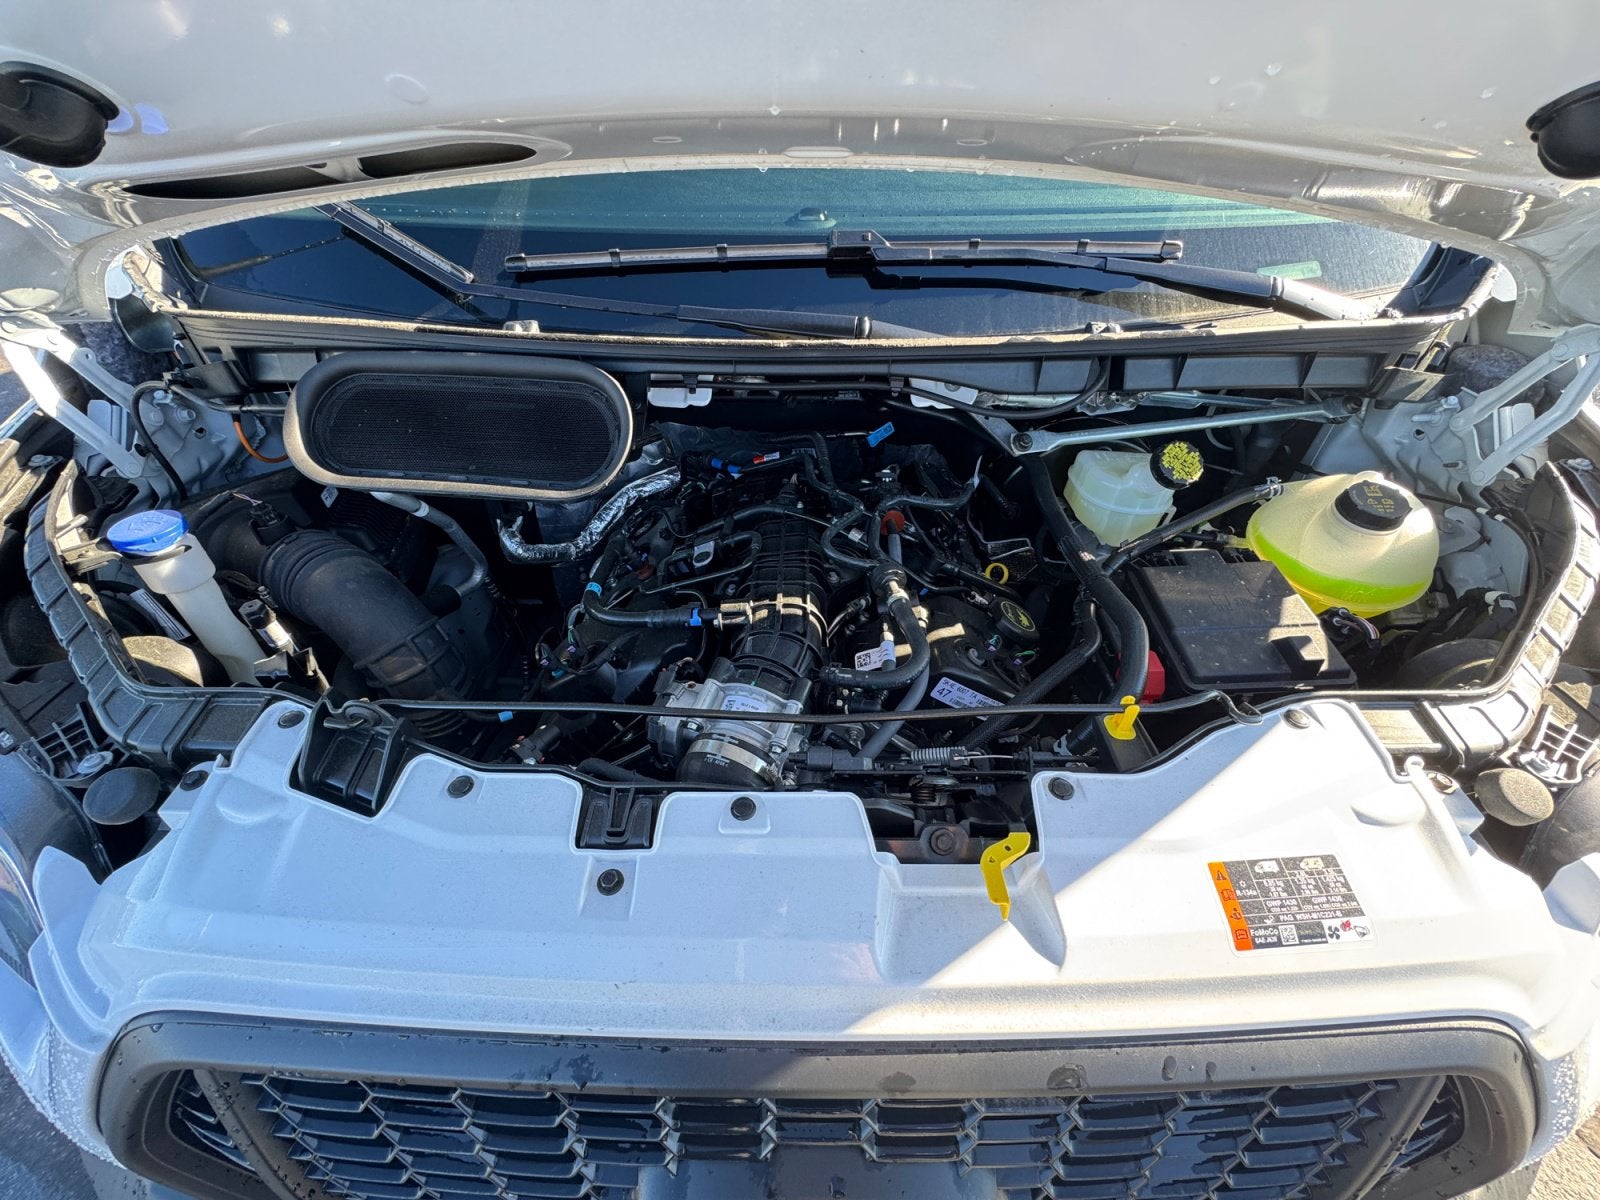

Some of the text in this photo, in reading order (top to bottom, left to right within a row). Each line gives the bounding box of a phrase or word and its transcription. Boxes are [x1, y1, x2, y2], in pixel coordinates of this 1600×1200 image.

[937, 688, 952, 697] 47
[1280, 914, 1293, 922] PAG
[1250, 928, 1279, 937] FoMoCo
